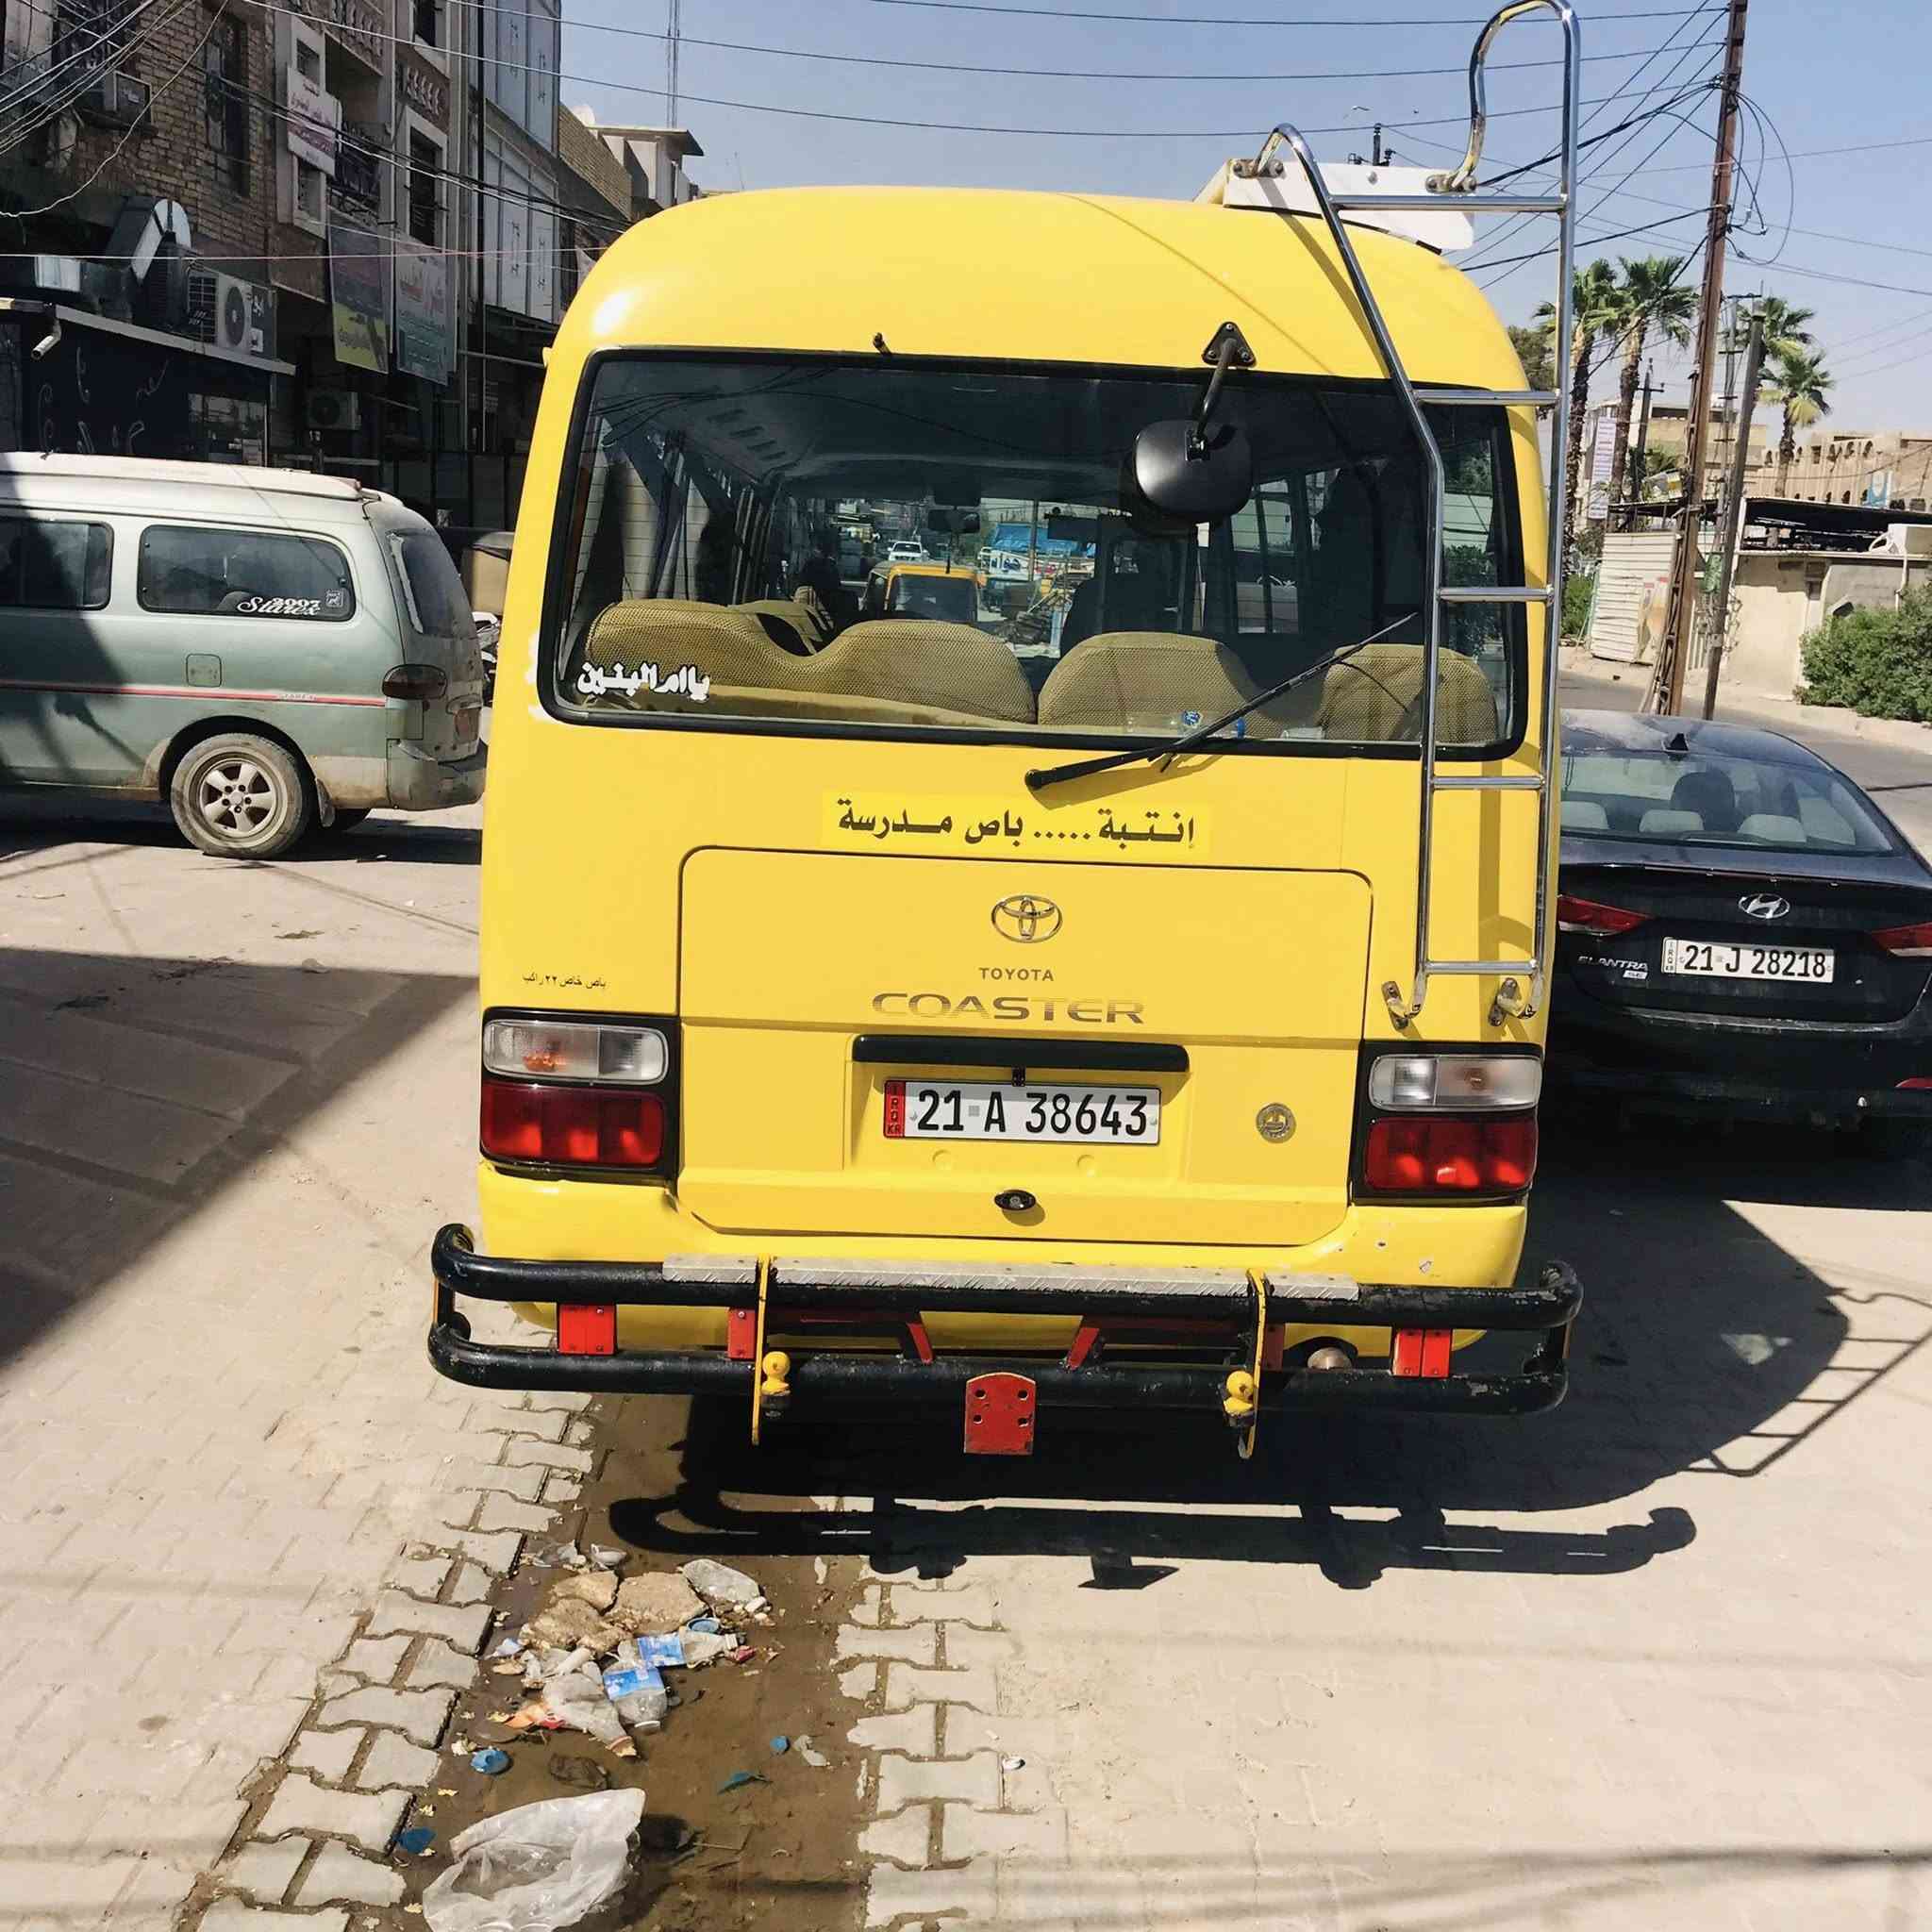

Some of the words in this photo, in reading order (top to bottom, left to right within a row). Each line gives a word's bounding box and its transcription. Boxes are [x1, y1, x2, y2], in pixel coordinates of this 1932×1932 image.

[837, 798, 955, 841] مدرسة
[964, 809, 1024, 847] باص
[978, 967, 1055, 982] TOYOTA
[1577, 955, 1649, 972] ELANTRA
[1684, 944, 1713, 973] 21
[1725, 946, 1742, 974] J
[1751, 947, 1826, 978] 28218
[871, 992, 1145, 1024] COASTER
[917, 1089, 964, 1132] 21
[984, 1091, 1007, 1134] A
[1025, 1091, 1148, 1137] 38643
